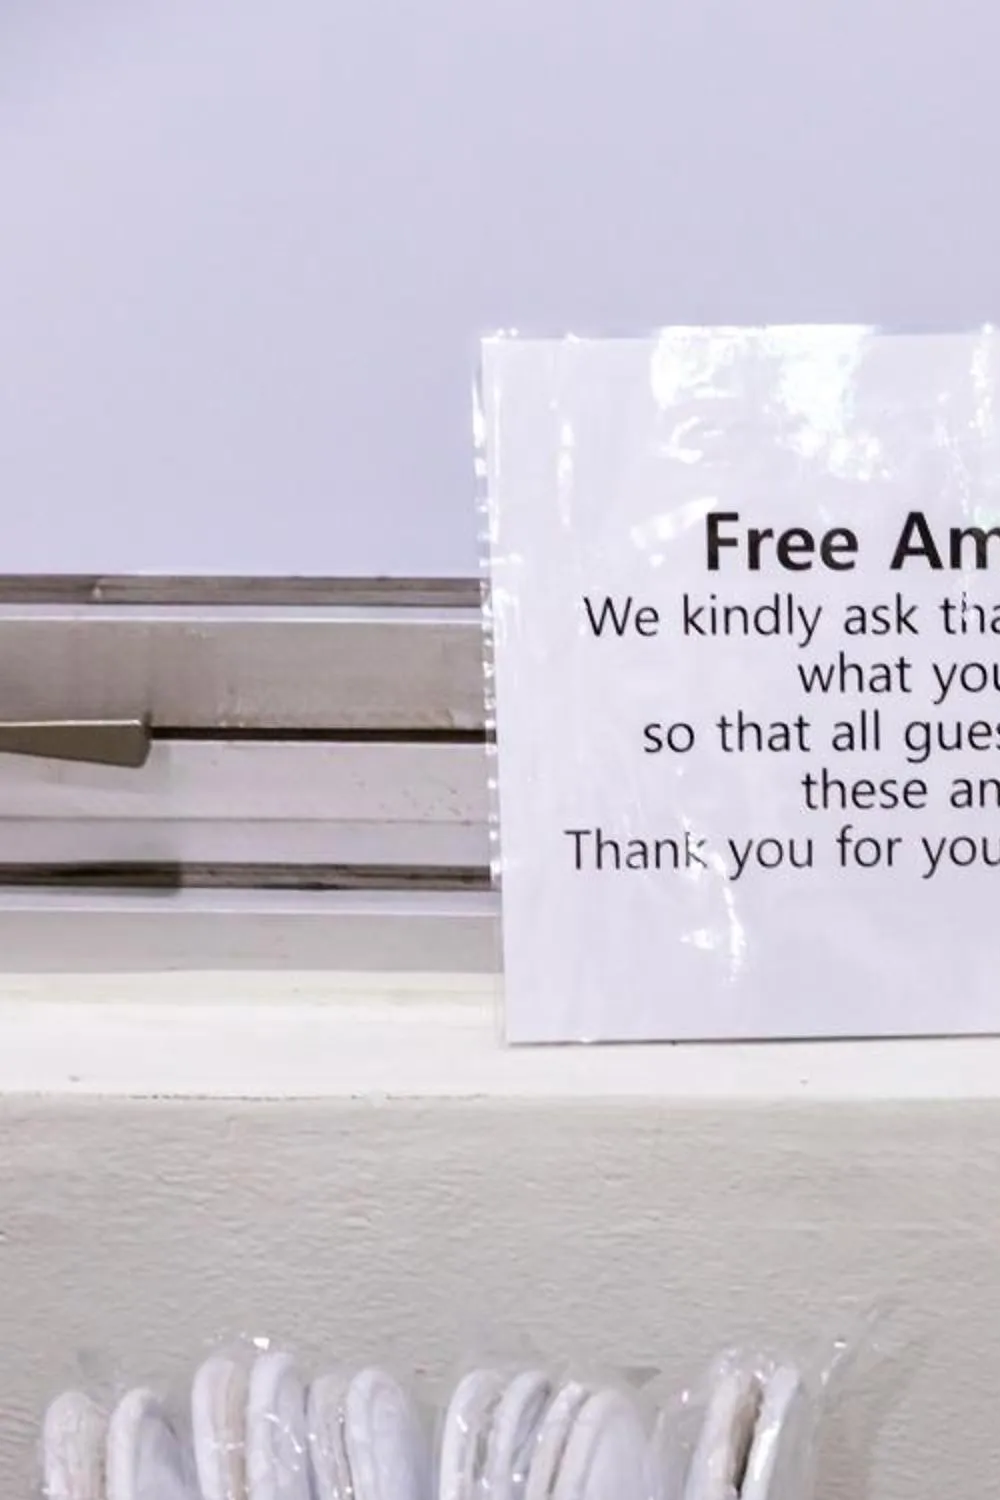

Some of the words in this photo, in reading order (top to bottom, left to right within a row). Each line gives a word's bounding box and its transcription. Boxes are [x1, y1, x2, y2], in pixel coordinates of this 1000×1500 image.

[706, 511, 859, 572] Free
[583, 596, 659, 637] We
[683, 592, 823, 649] kindly
[843, 592, 919, 636] ask
[797, 651, 912, 694] what
[643, 722, 695, 754] so
[716, 710, 811, 753] that
[831, 709, 880, 752] all
[801, 767, 928, 810] these
[564, 827, 707, 870] Thank
[728, 838, 813, 881] you
[835, 824, 903, 868] for
